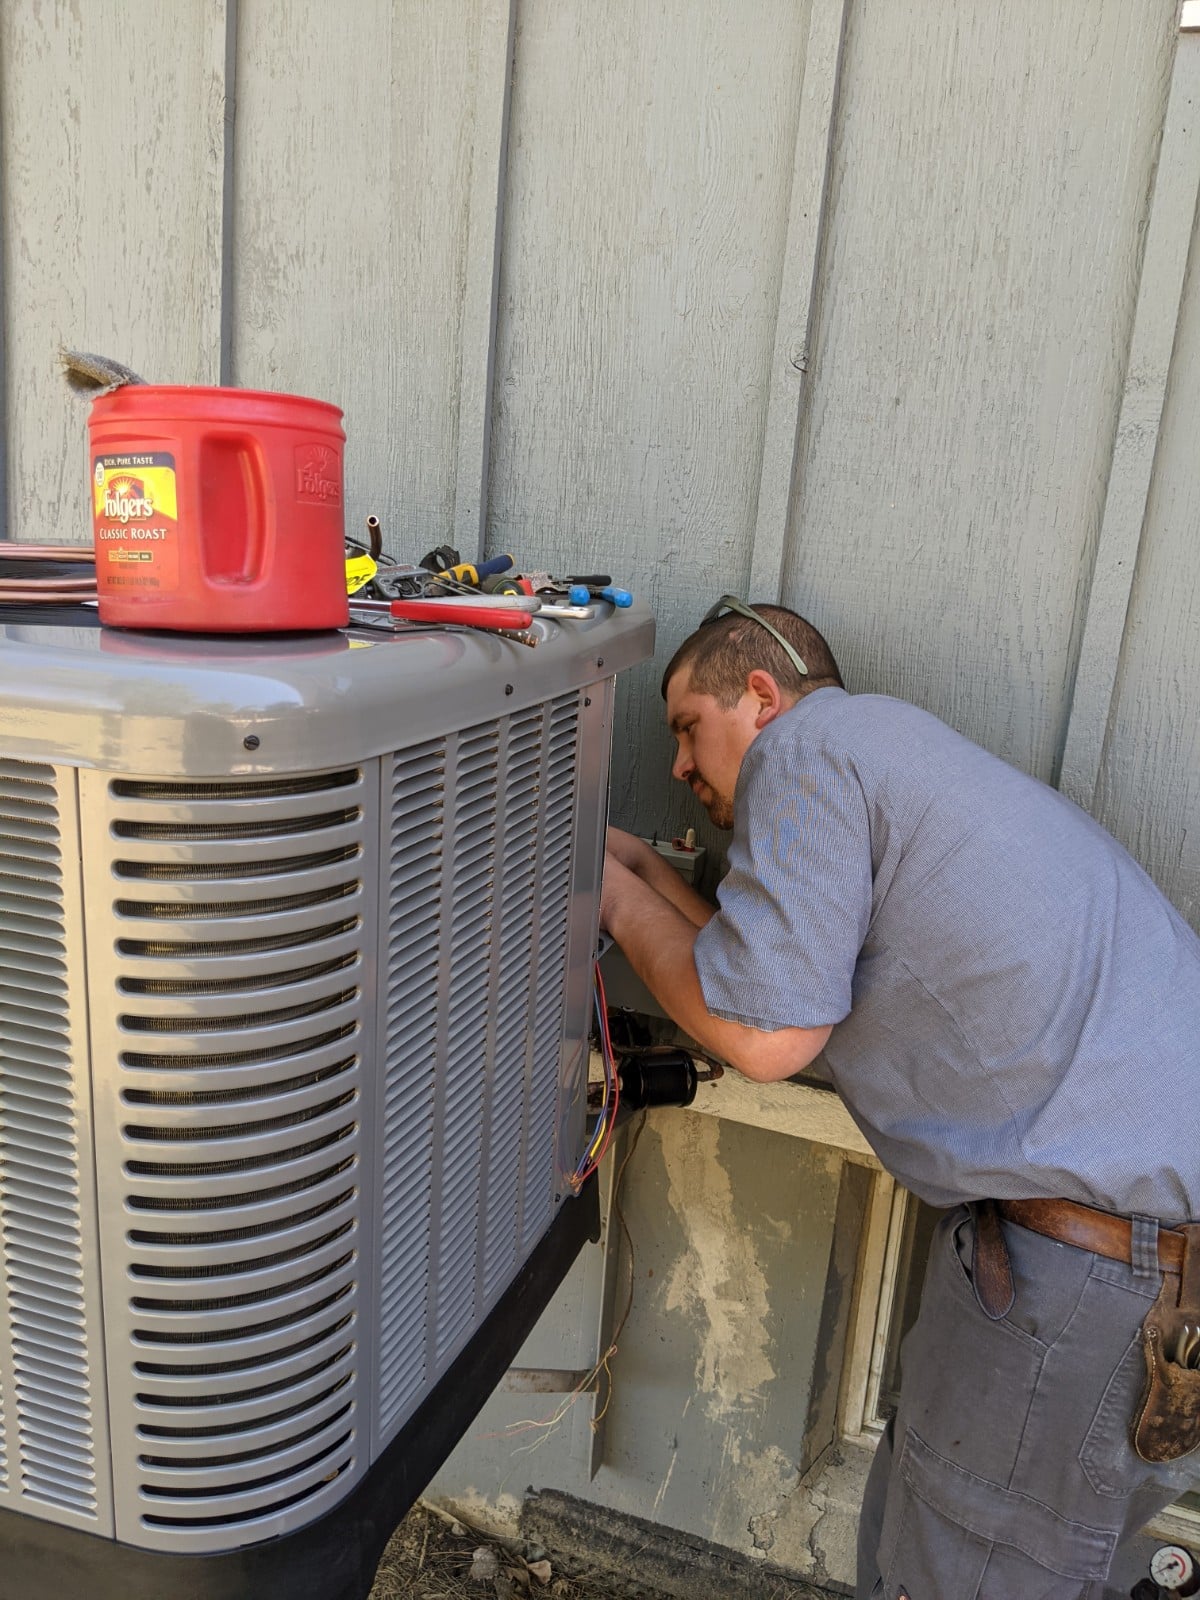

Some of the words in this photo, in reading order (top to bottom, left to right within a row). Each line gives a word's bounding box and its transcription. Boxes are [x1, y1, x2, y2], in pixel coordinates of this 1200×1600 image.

[117, 457, 131, 465] PURE
[133, 456, 153, 464] TASTE
[104, 490, 153, 523] Folgers
[99, 528, 128, 540] CLASSIC
[131, 528, 167, 540] ROAST
